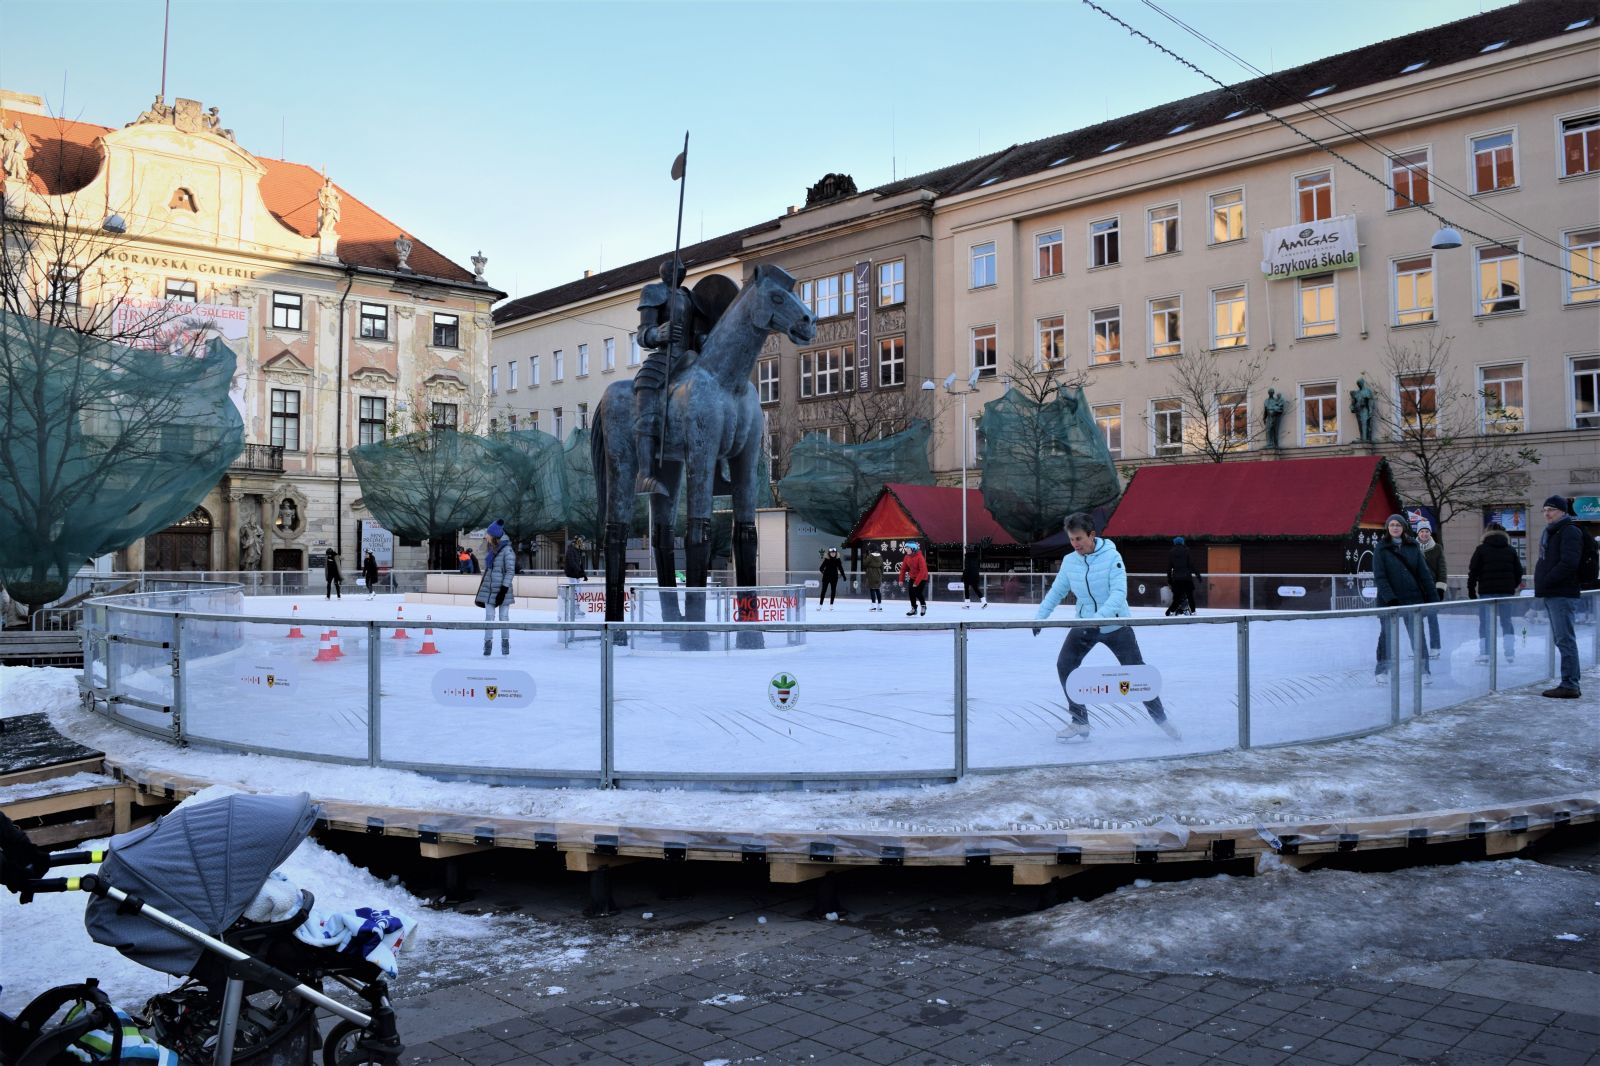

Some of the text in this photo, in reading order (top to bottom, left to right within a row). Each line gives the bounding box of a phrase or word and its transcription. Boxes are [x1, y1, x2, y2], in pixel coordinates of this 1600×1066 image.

[198, 263, 257, 280] GALERIE
[1267, 249, 1354, 277] Jazyková škola
[196, 305, 246, 321] GALERIE
[733, 592, 798, 610] MORAVSKÁ
[733, 609, 785, 623] GALERIE
